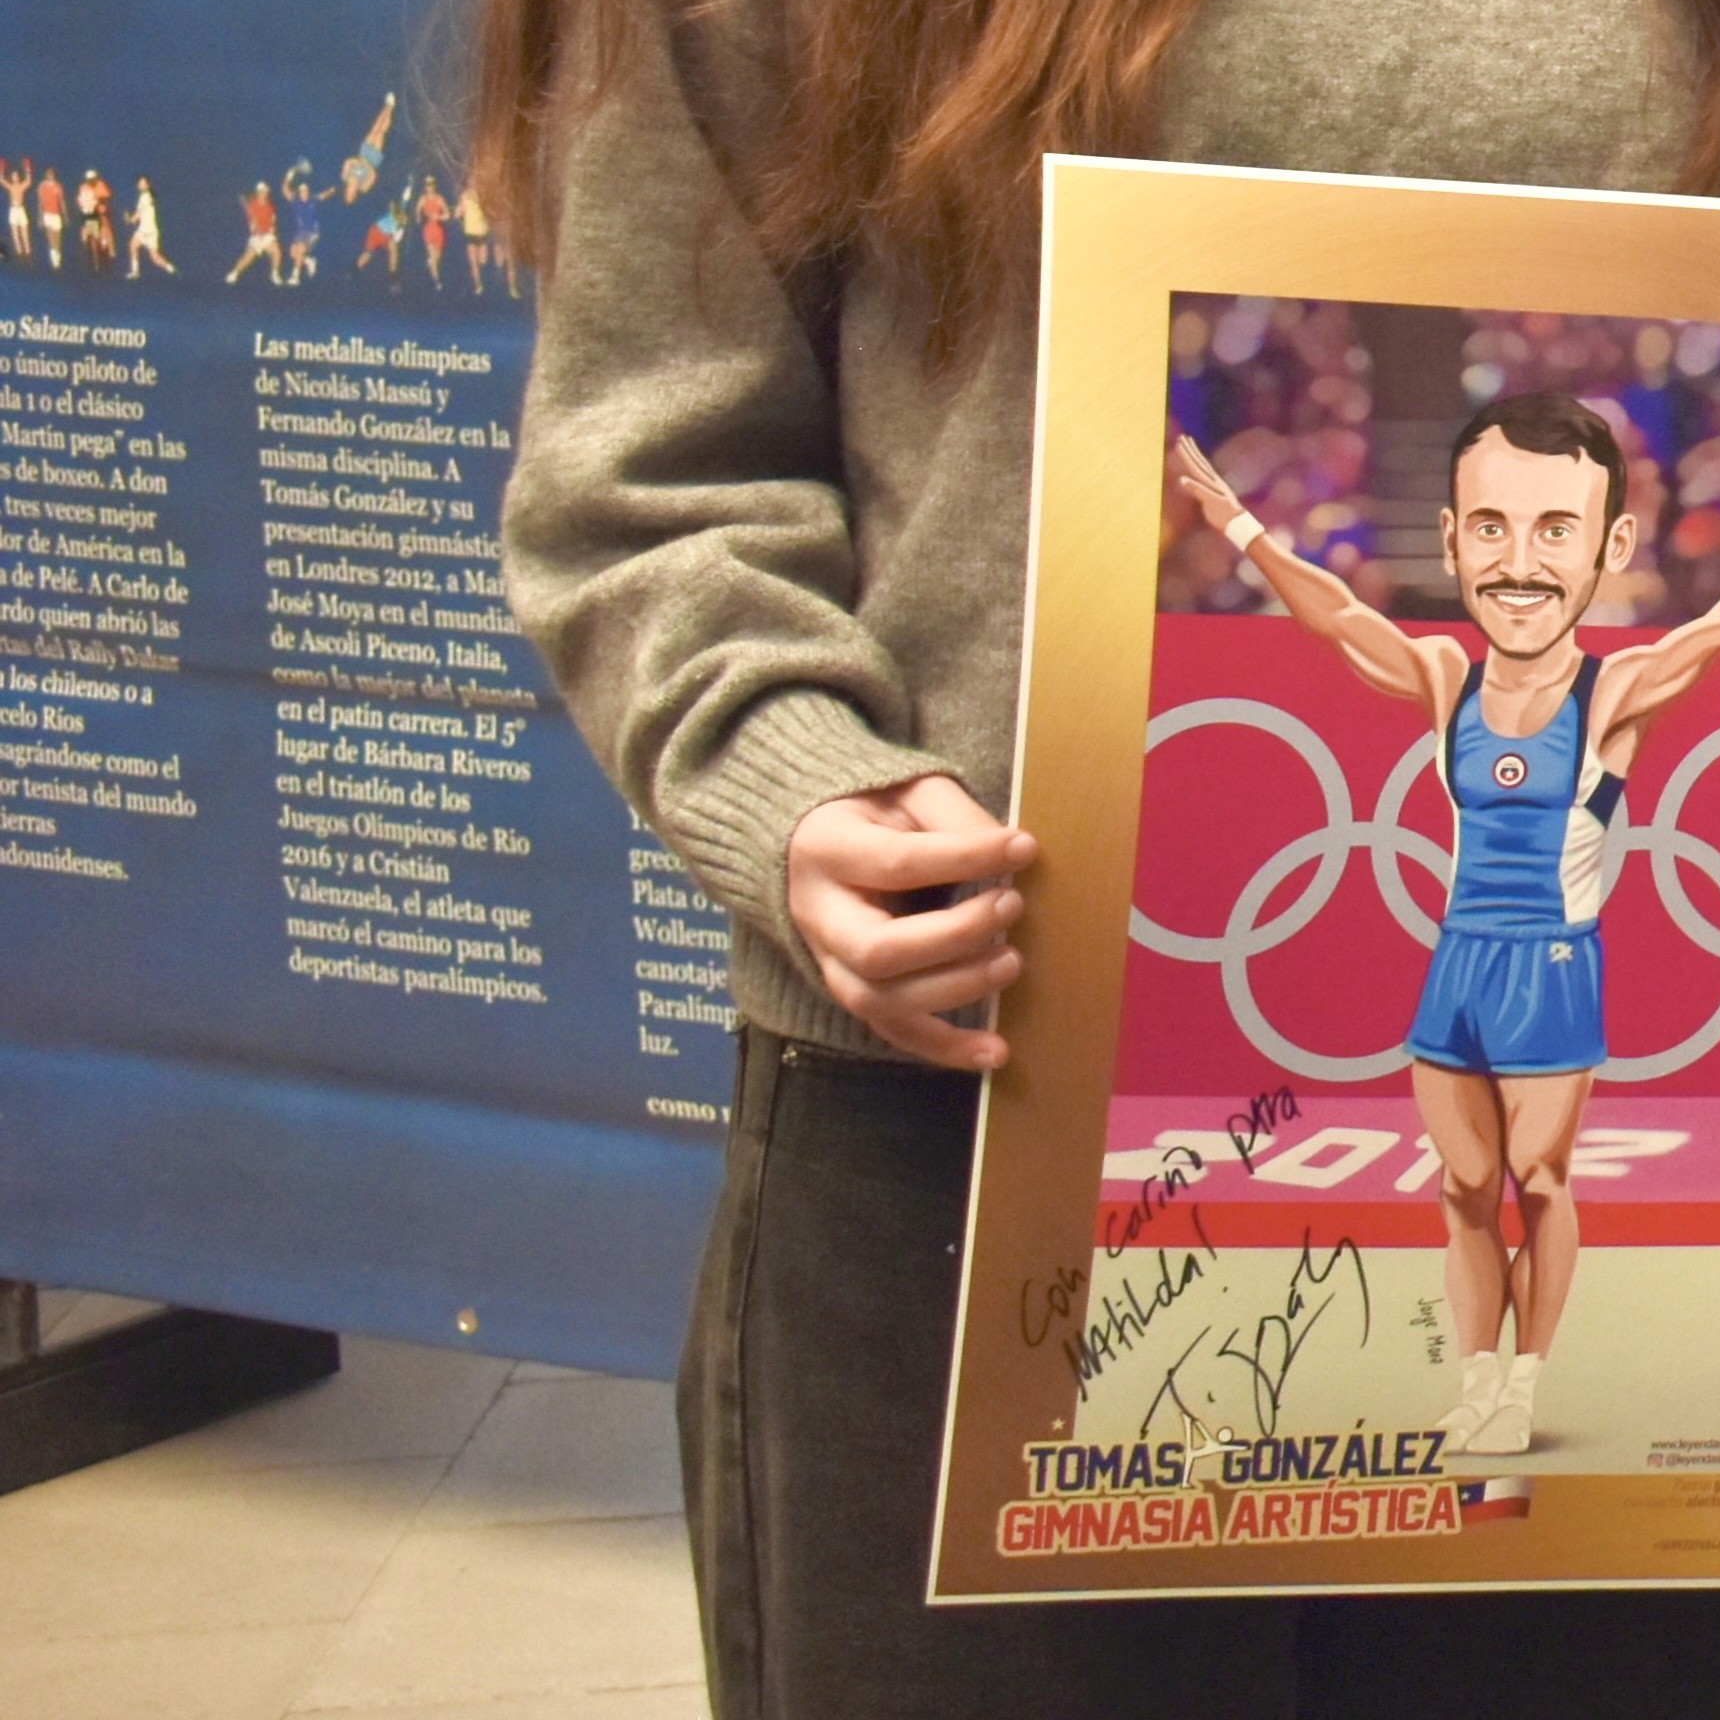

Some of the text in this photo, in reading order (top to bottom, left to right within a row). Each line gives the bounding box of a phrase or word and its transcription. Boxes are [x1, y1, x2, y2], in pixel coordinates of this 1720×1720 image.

[19, 316, 147, 348] Salazar como
[255, 332, 290, 359] Las
[294, 336, 386, 365] medallas
[129, 438, 154, 458] en
[158, 433, 187, 460] las
[258, 406, 357, 436] Fernando
[459, 427, 486, 448] en
[491, 421, 511, 450] la
[450, 500, 475, 521] su
[27, 529, 51, 555] de
[138, 546, 164, 565] en
[167, 540, 186, 568] la
[39, 604, 92, 632] quien
[152, 611, 180, 639] las
[271, 624, 296, 650] de
[300, 629, 361, 656] Ascoli
[278, 701, 303, 722] en
[307, 697, 326, 724] el
[475, 714, 497, 741] El
[277, 730, 330, 764] lugar
[333, 736, 359, 763] de
[452, 749, 532, 781] Riveros
[23, 778, 197, 817] tenista del mundo
[278, 804, 350, 838] Juegos
[461, 823, 488, 851] de
[403, 890, 422, 917] el
[426, 894, 487, 924] atleta
[491, 907, 532, 932] que
[633, 879, 688, 909] Plata
[289, 947, 400, 985] deportistas
[635, 961, 728, 991] canotaje
[647, 1098, 717, 1122] como
[1030, 1419, 1448, 1492] TOMÁS GONZÁLEZ
[1003, 1481, 1457, 1552] GIMNASIA ARTÍSTICA
